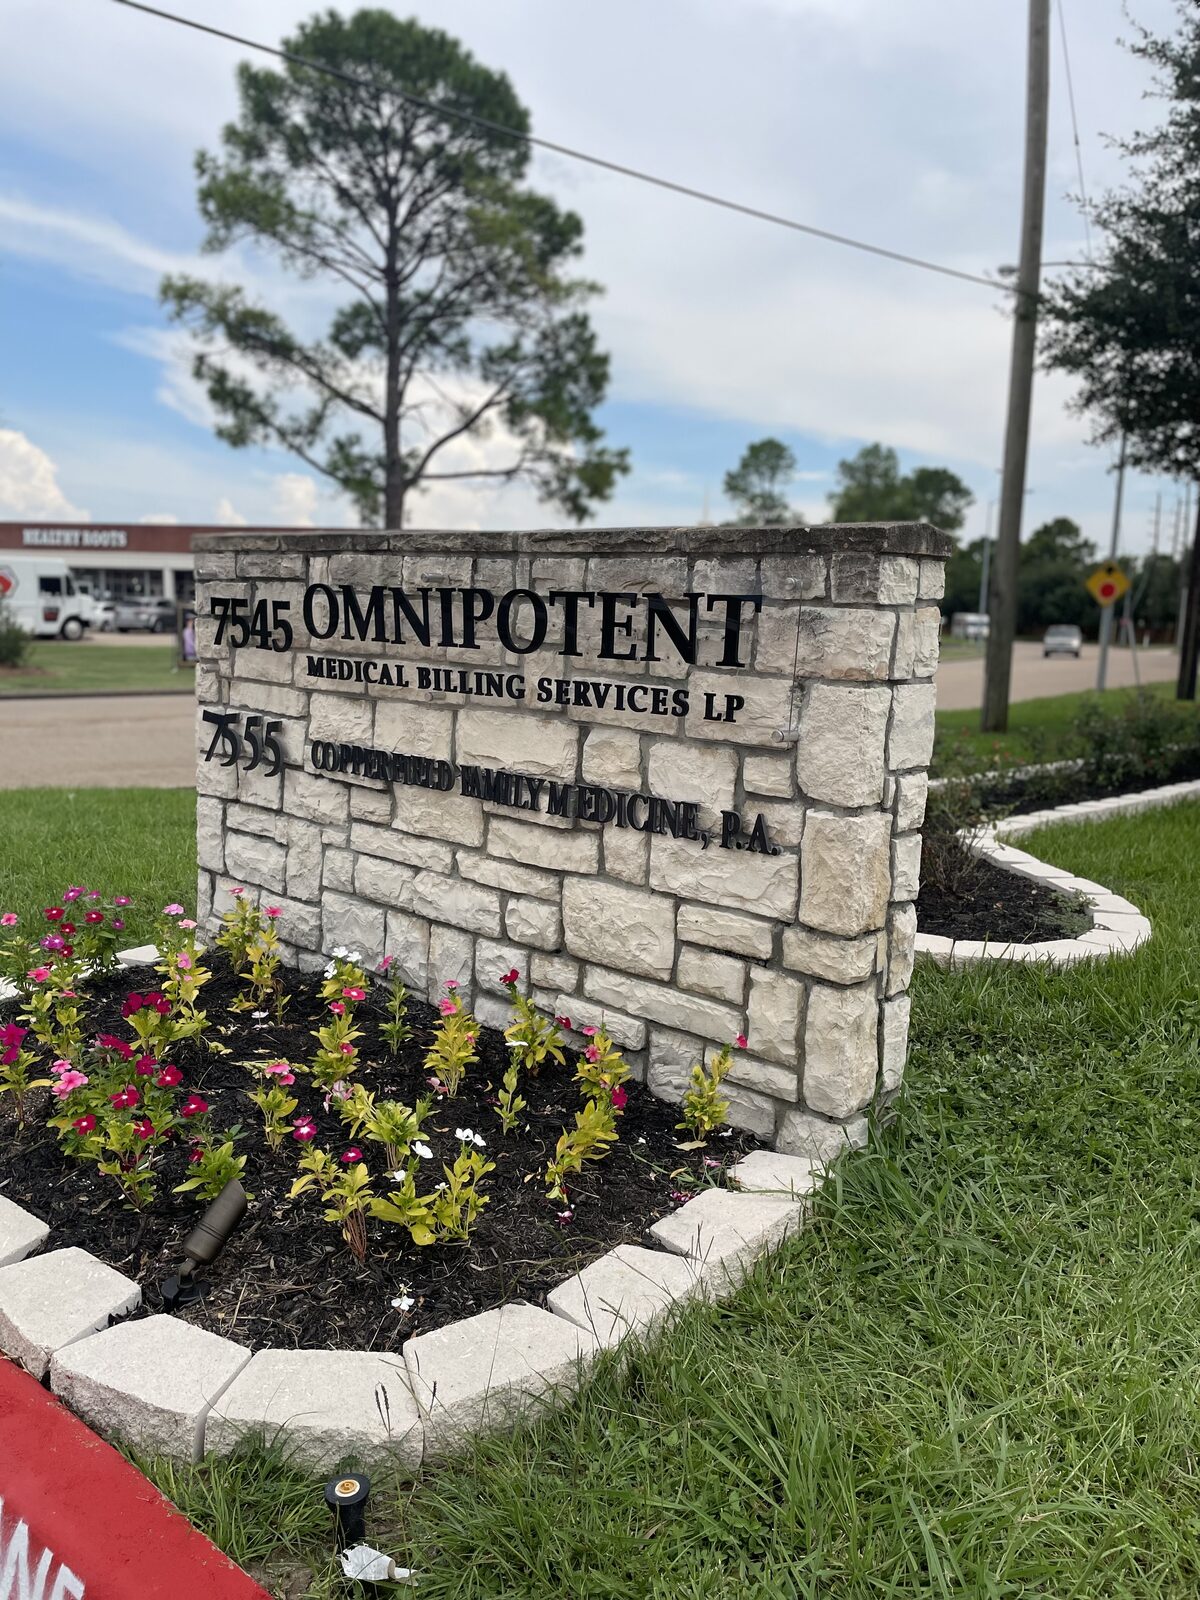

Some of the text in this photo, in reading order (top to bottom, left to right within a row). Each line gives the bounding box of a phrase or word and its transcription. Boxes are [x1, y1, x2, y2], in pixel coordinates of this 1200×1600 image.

[82, 530, 128, 547] ROOTS
[210, 597, 293, 652] 7545
[302, 583, 762, 668] OMNIPOTENT
[306, 655, 745, 723] MEDICAL BILLING SERVICES LP
[202, 709, 283, 778] 7555
[546, 782, 709, 850] MEDICINE,
[719, 809, 780, 856] P.A.
